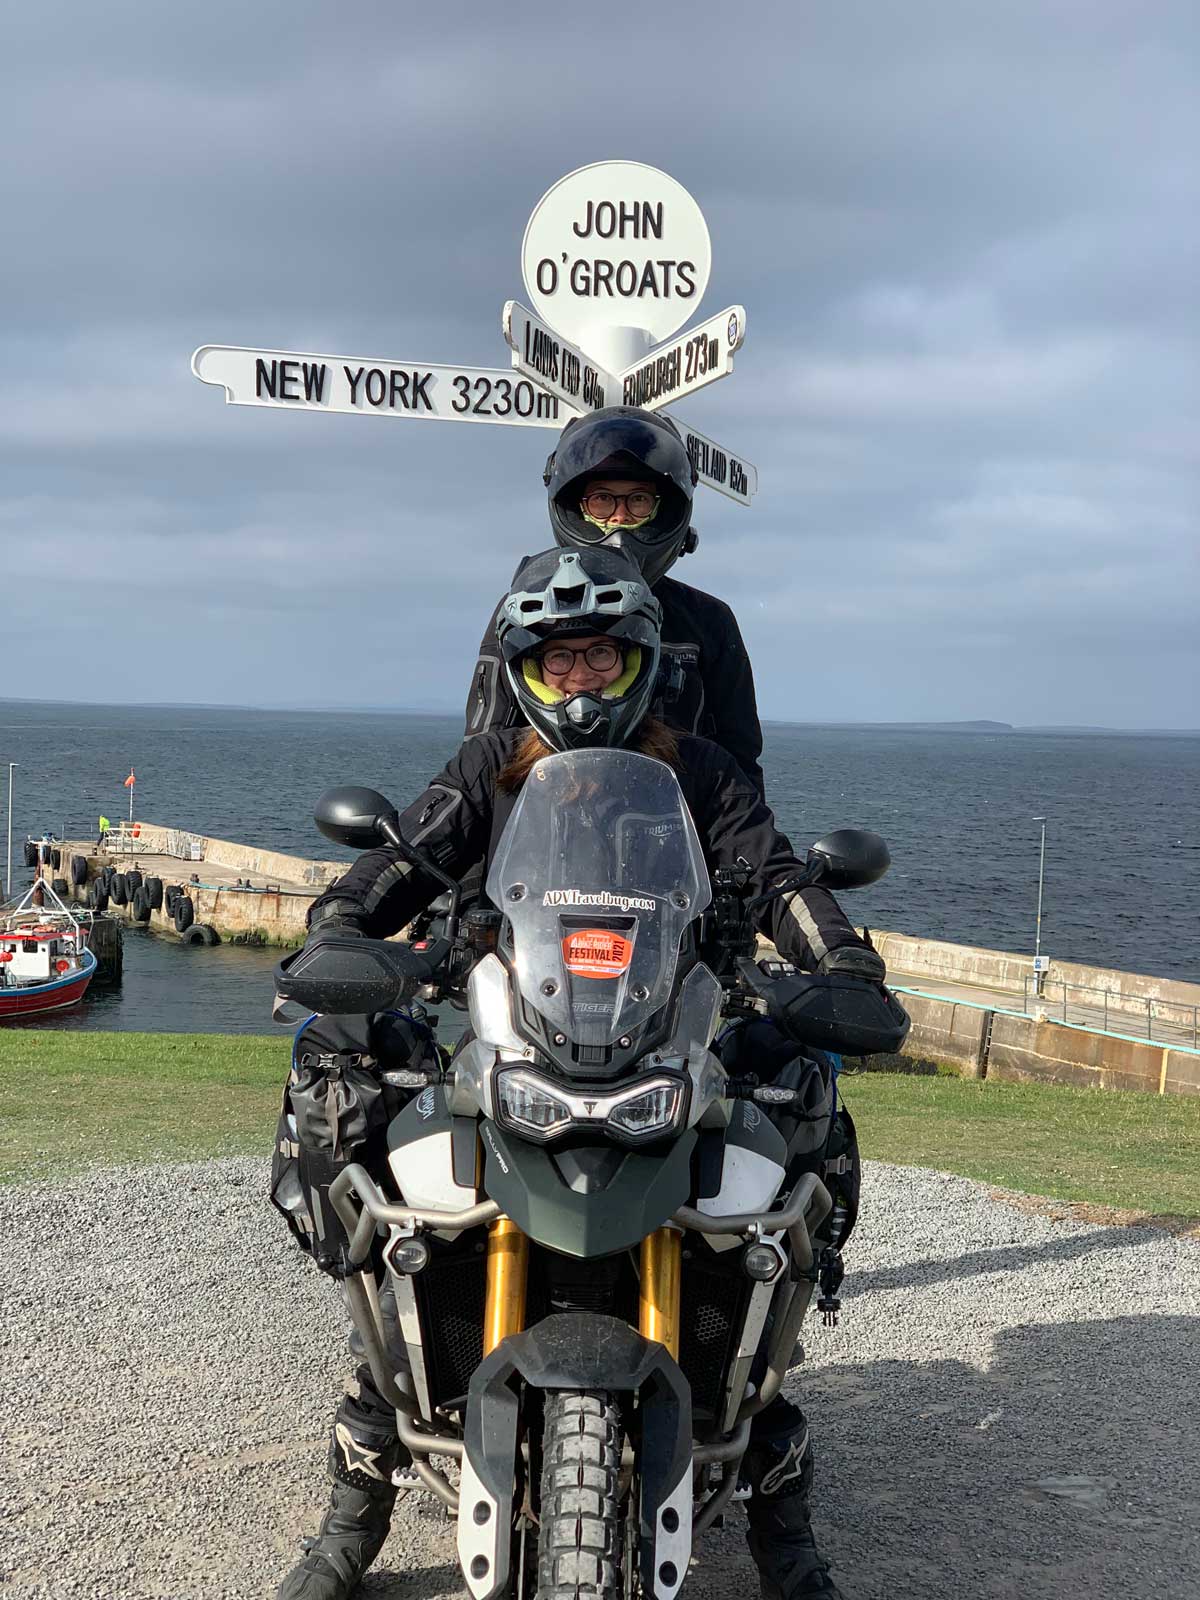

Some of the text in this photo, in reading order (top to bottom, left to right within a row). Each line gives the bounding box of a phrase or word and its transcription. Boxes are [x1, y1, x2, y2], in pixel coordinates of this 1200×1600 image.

[572, 200, 663, 239] JOHN
[536, 252, 696, 299] O'GROATS
[255, 358, 560, 419] NEW YORK 3230m
[561, 348, 581, 397] END
[622, 333, 719, 408] EDINBURGH 273m
[569, 947, 611, 961] FESTIVAL
[612, 940, 625, 962] 2021
[572, 1002, 615, 1014] TIGER
